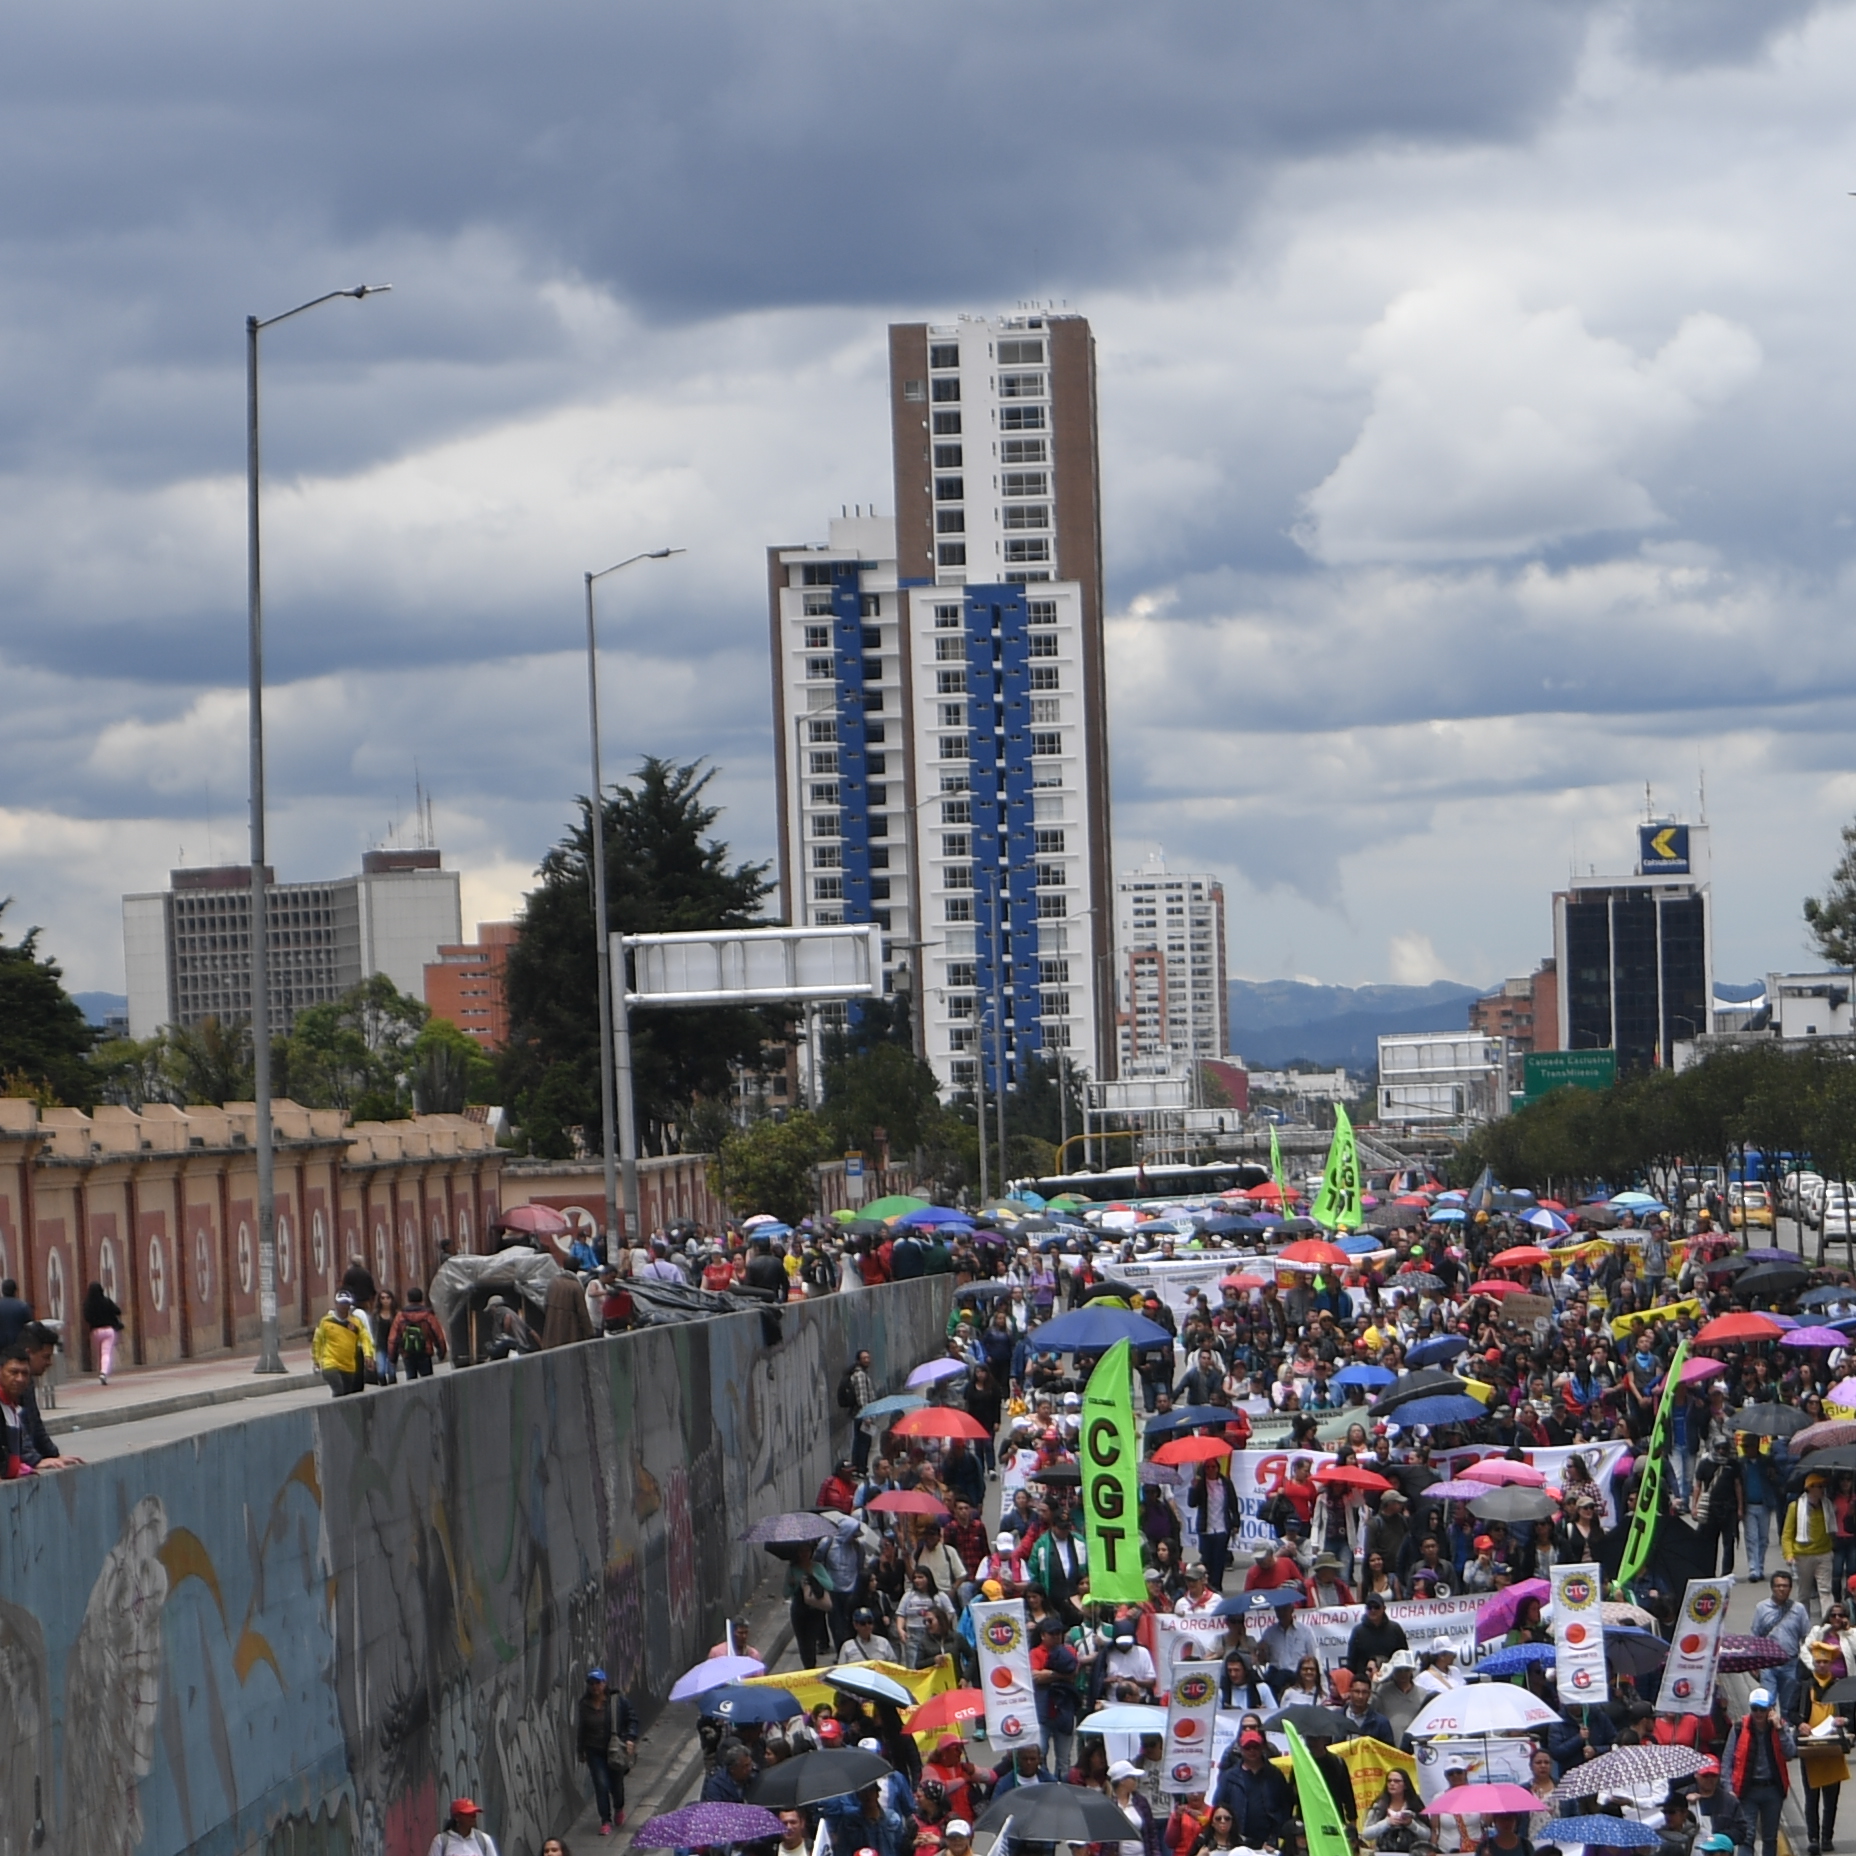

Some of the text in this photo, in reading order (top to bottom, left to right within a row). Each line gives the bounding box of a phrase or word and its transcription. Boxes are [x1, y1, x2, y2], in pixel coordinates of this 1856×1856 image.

[1528, 1055, 1611, 1067] Calzada Exclusiva
[1541, 1068, 1599, 1078] TransMilenio
[1088, 1417, 1126, 1573] CGT
[1565, 1586, 1589, 1595] CTC
[1696, 1599, 1715, 1609] CTC
[1161, 1619, 1176, 1631] LA
[1390, 1604, 1425, 1619] UCHA
[1428, 1600, 1454, 1615] NOS
[955, 1707, 976, 1719] CTC
[1426, 1718, 1457, 1730] CTC
